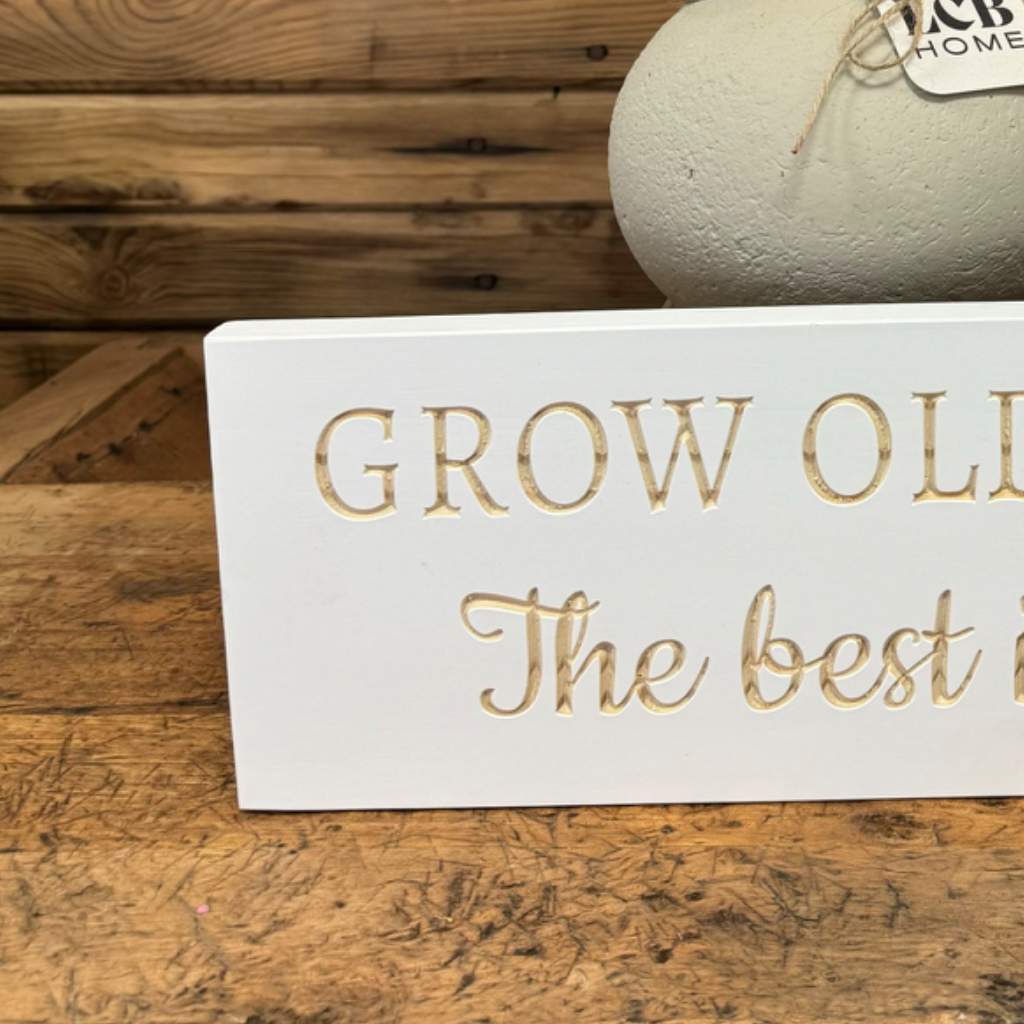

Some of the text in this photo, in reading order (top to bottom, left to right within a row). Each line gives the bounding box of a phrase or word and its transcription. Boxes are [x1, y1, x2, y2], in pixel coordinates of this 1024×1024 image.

[314, 395, 755, 520] GROW
[460, 586, 708, 717] The
[741, 585, 982, 711] best
